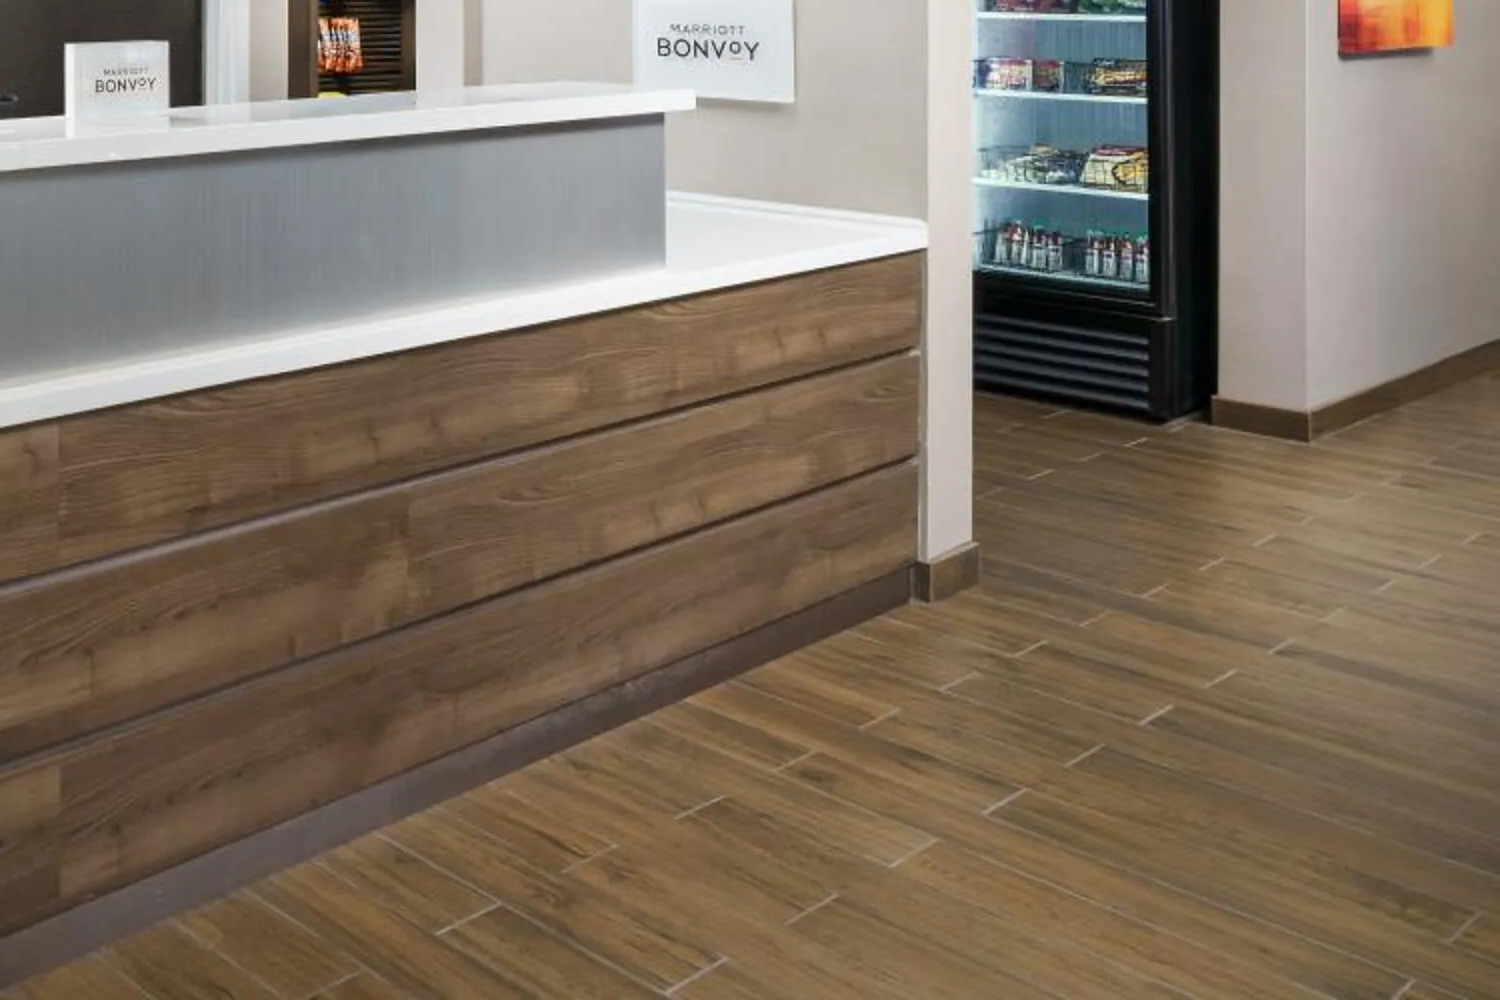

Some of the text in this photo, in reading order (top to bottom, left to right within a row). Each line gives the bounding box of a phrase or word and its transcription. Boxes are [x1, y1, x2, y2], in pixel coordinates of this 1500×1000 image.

[669, 23, 746, 35] MARRIOTT
[657, 37, 759, 61] BONVOY
[95, 77, 156, 93] BONVOY
